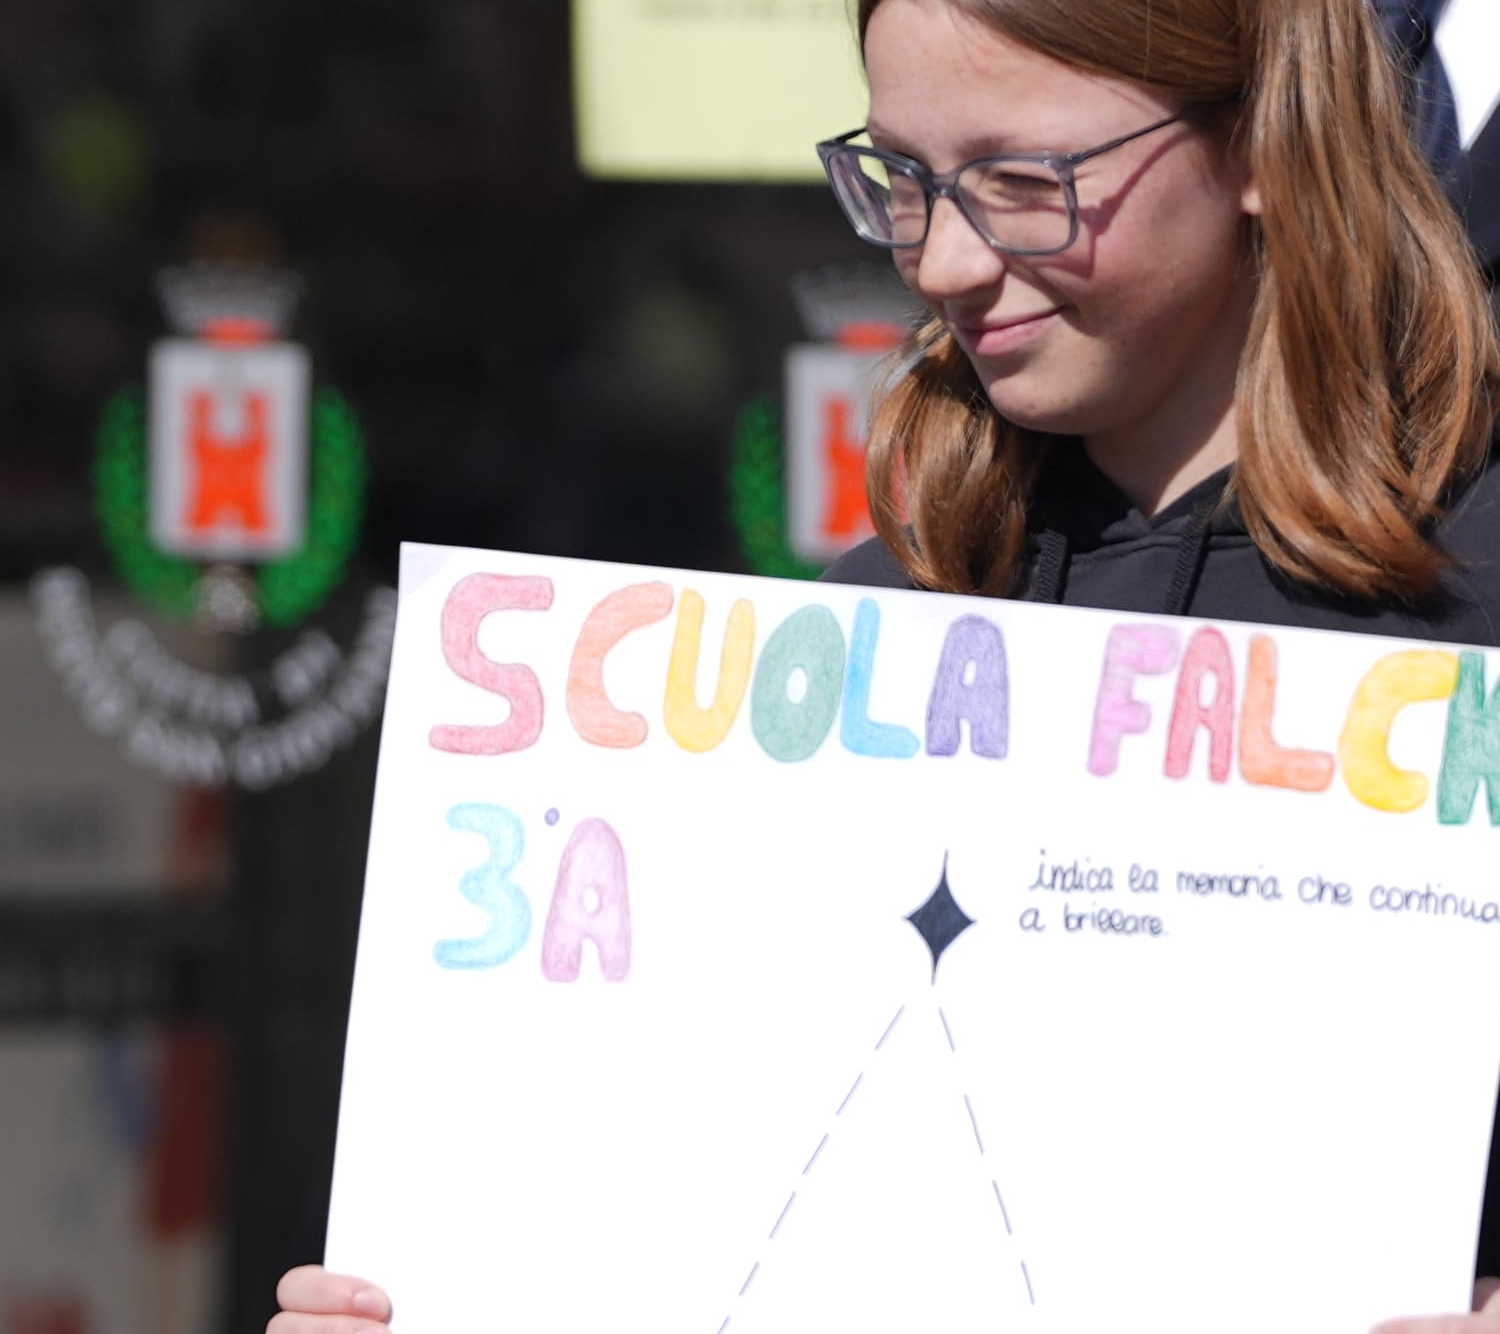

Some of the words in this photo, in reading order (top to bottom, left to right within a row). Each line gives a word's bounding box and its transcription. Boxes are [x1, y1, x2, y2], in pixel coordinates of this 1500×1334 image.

[428, 570, 1010, 763] SCUOLA
[1028, 847, 1114, 892] indica
[1128, 862, 1159, 893] la
[1176, 864, 1282, 901] memoria
[1297, 874, 1353, 906] che
[1018, 907, 1047, 932] a
